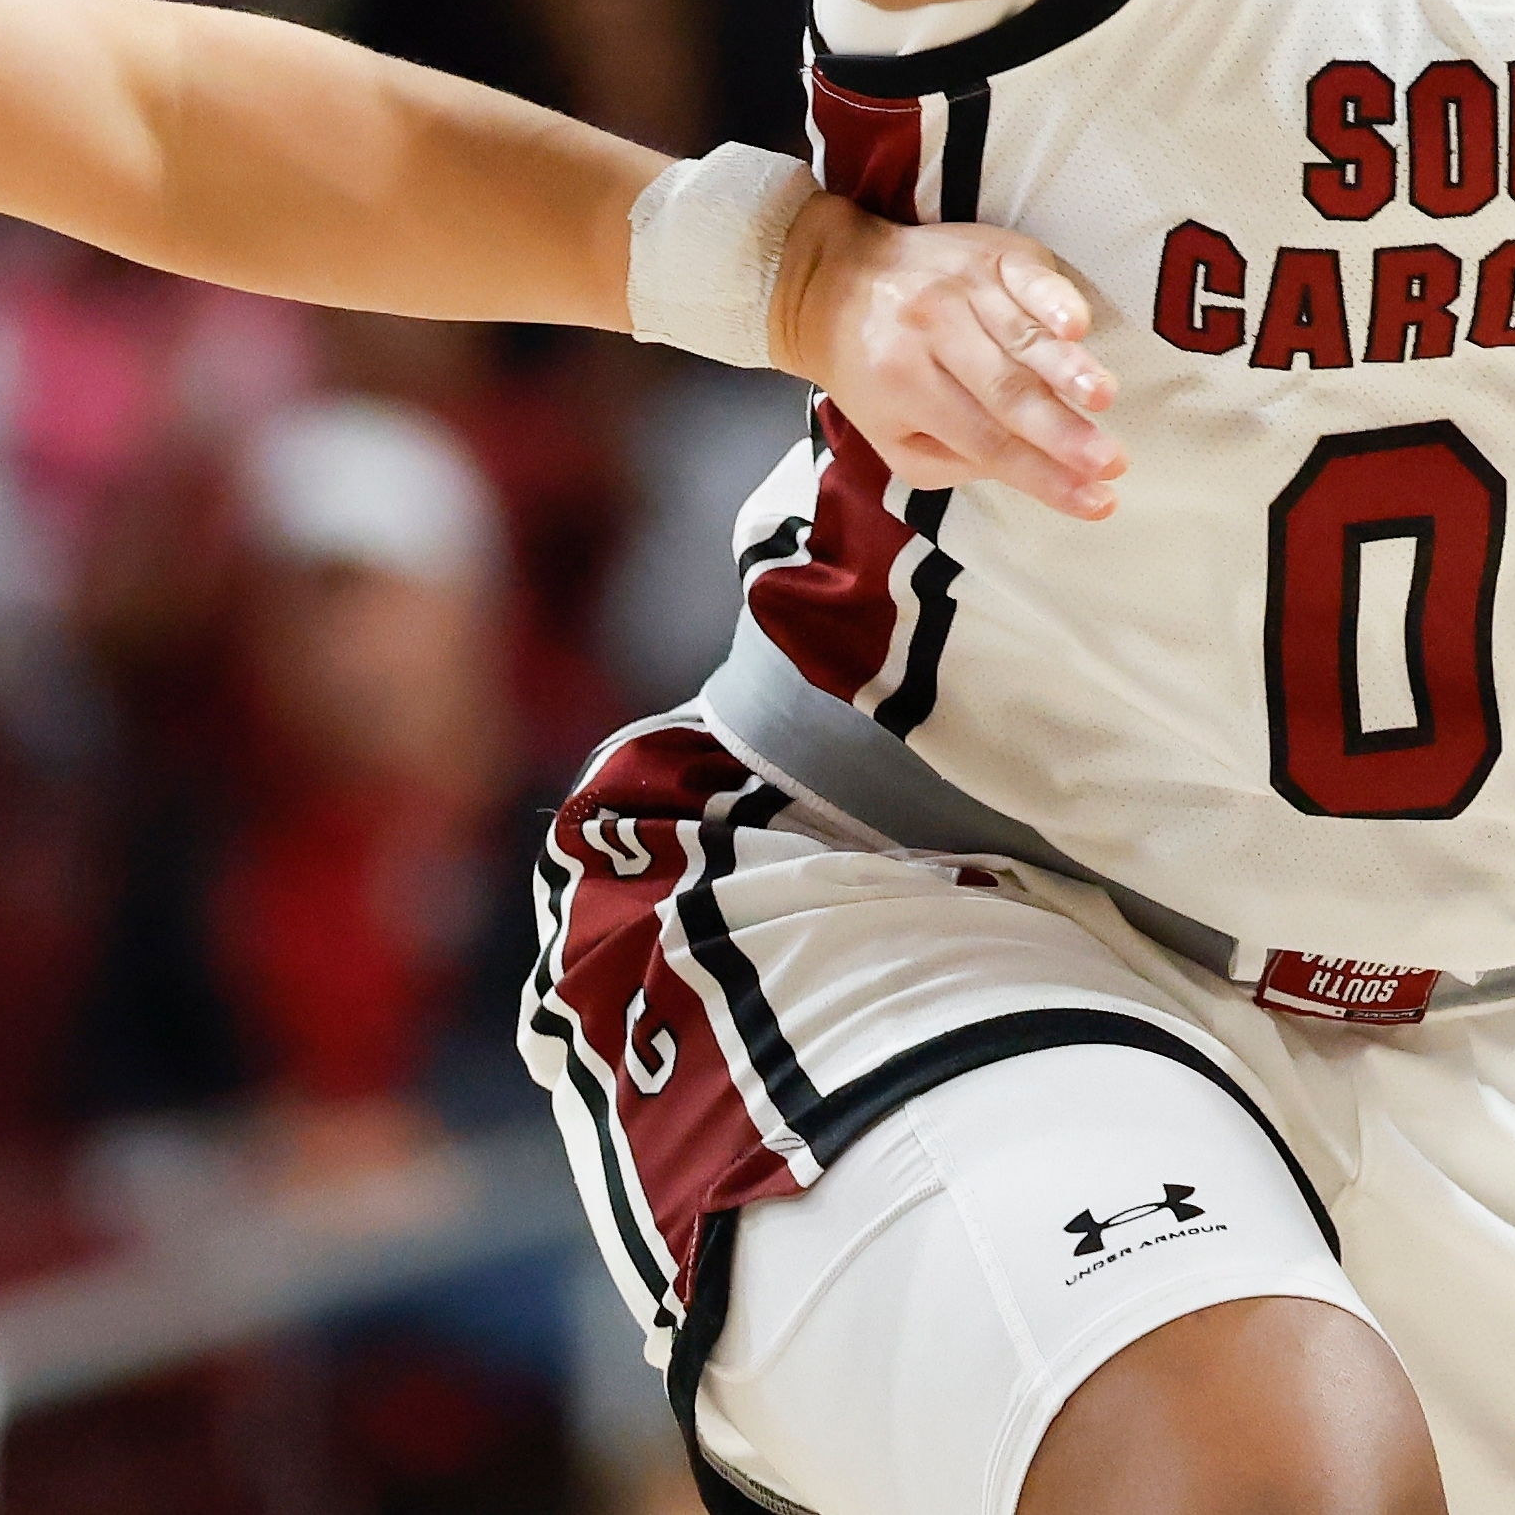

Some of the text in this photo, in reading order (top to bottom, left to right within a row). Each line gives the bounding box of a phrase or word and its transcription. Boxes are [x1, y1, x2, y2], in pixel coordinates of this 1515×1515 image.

[1307, 970, 1399, 1004] SOUTH
[1065, 1224, 1228, 1286] UNDER ARMOUR
